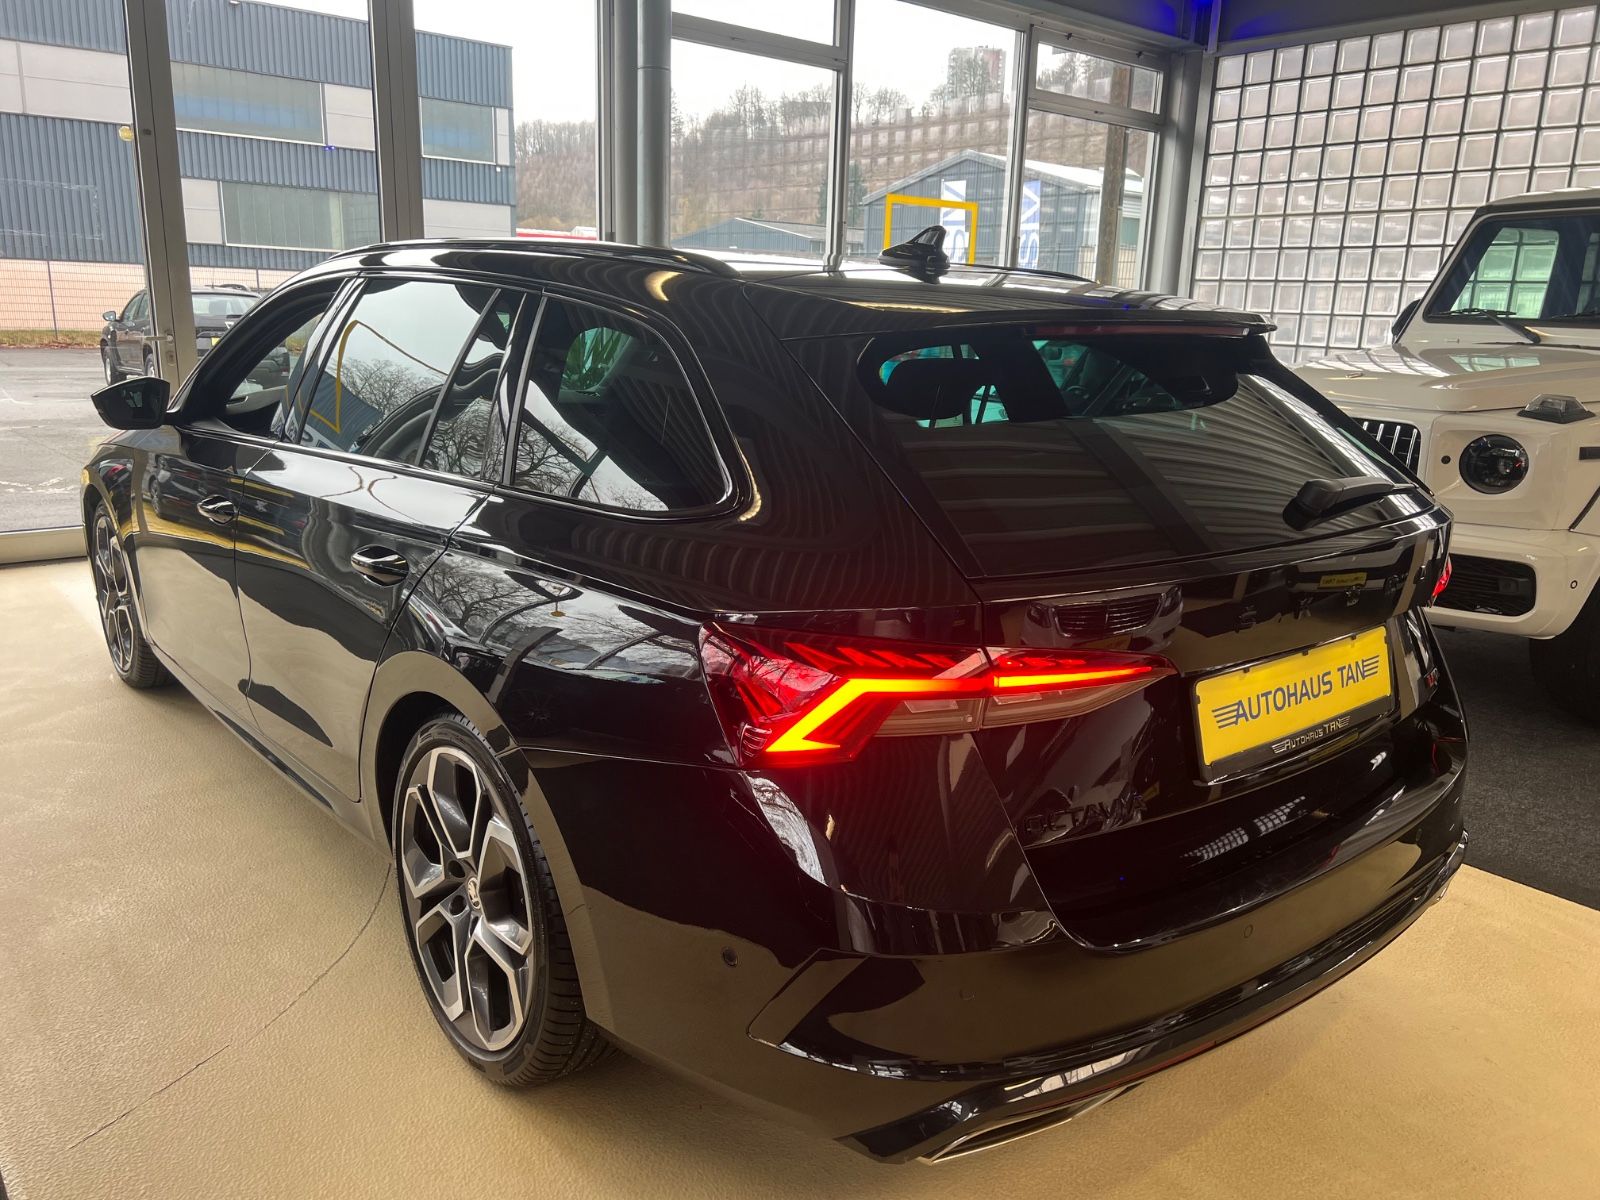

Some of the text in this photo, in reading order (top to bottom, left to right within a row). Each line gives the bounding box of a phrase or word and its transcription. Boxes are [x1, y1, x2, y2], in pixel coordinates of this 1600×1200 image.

[1234, 658, 1367, 726] AUTOHAUS TAN
[1283, 715, 1343, 751] AUTOHAUS TAN
